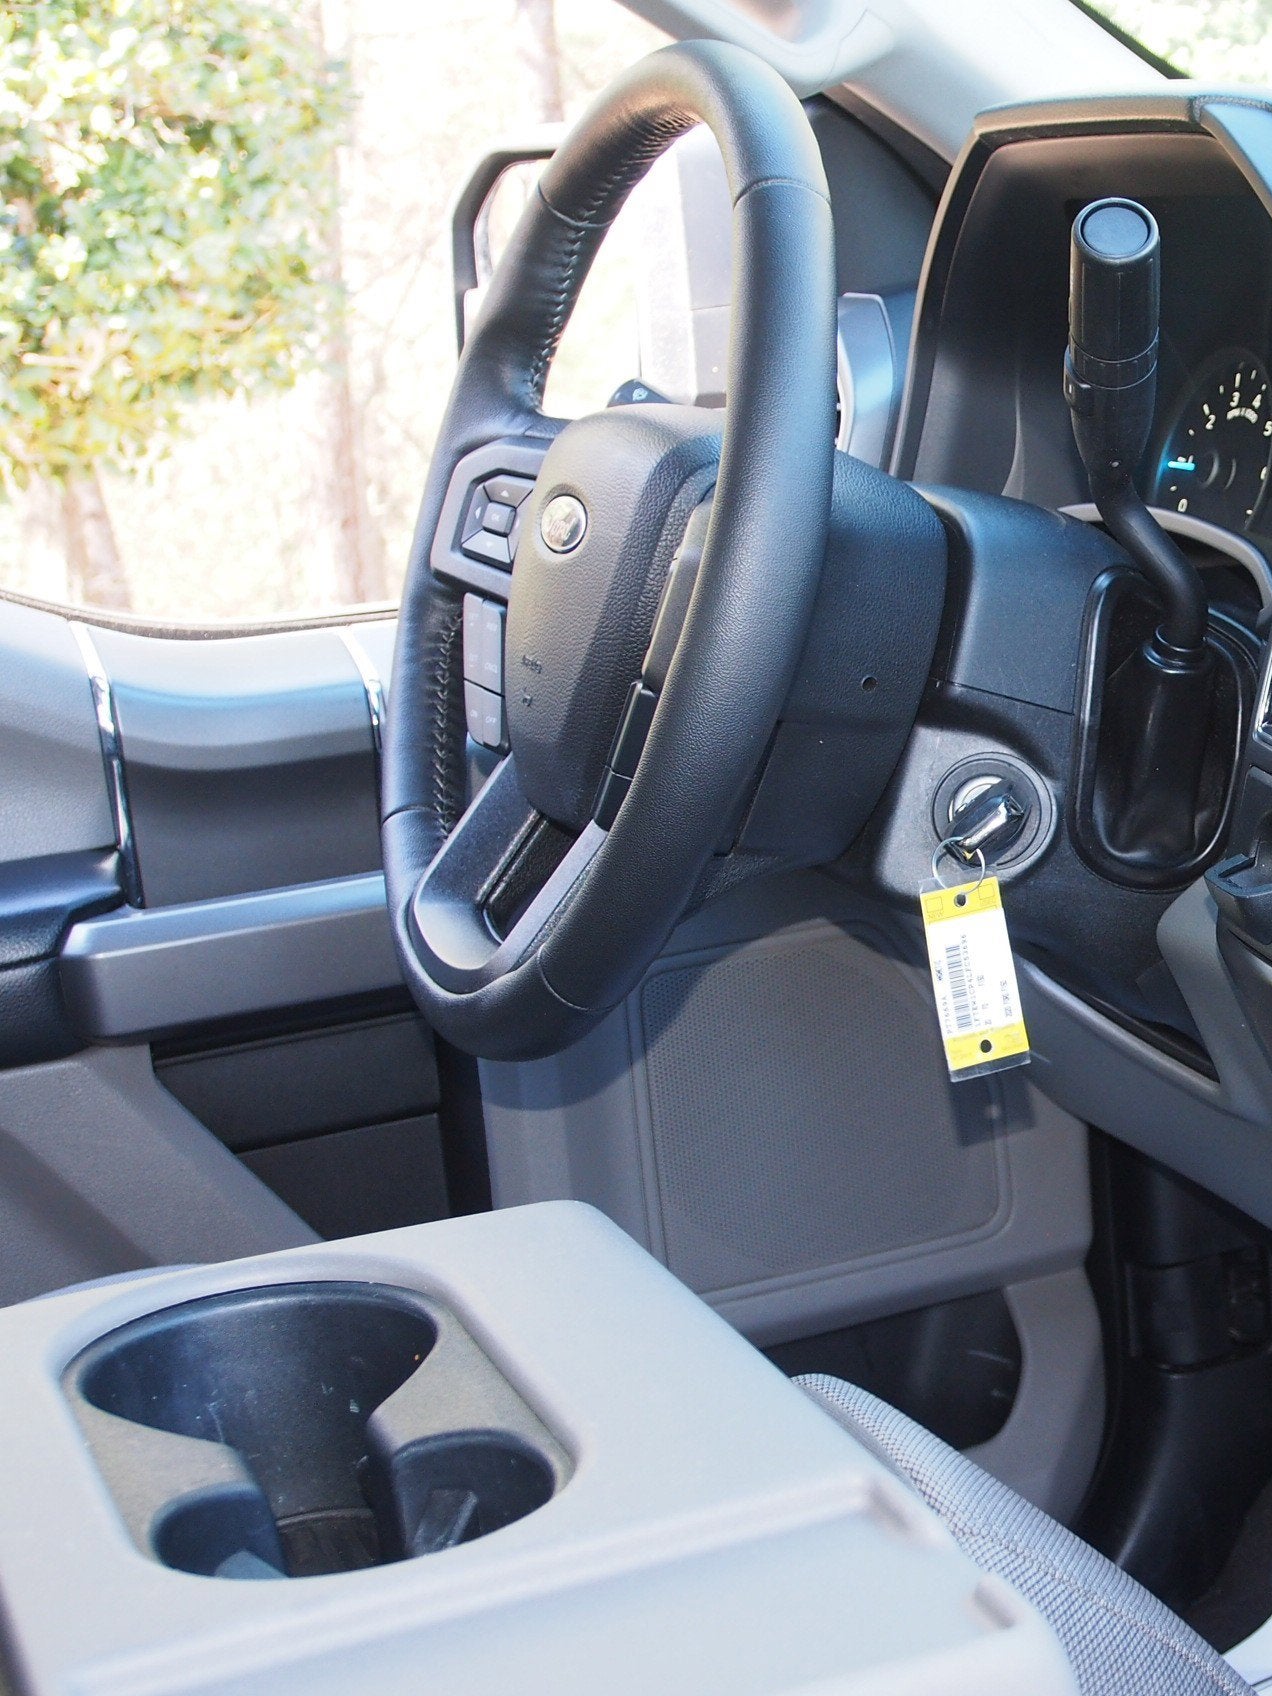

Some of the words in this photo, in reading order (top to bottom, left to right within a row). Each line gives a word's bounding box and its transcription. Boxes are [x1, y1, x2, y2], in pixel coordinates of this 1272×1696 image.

[1229, 391, 1240, 407] 3
[1252, 393, 1262, 409] 4
[1205, 414, 1216, 430] 2
[1263, 420, 1272, 437] 5
[1177, 498, 1188, 513] 0
